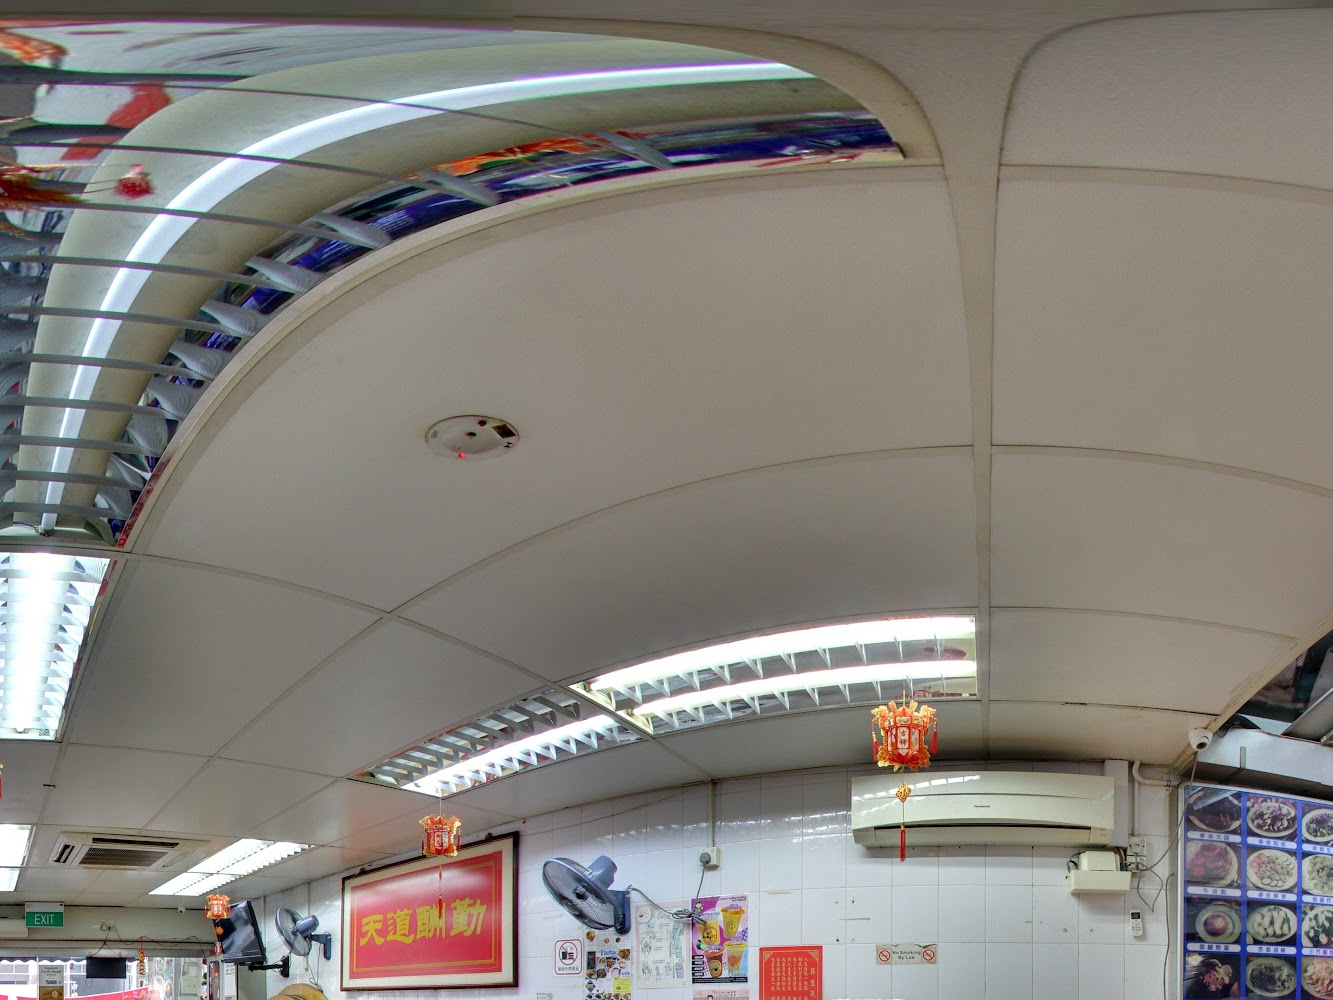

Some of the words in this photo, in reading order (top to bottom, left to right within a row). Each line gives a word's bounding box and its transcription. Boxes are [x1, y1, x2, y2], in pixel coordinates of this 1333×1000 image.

[34, 913, 55, 925] EXIT
[359, 897, 487, 946] 天道酬勤
